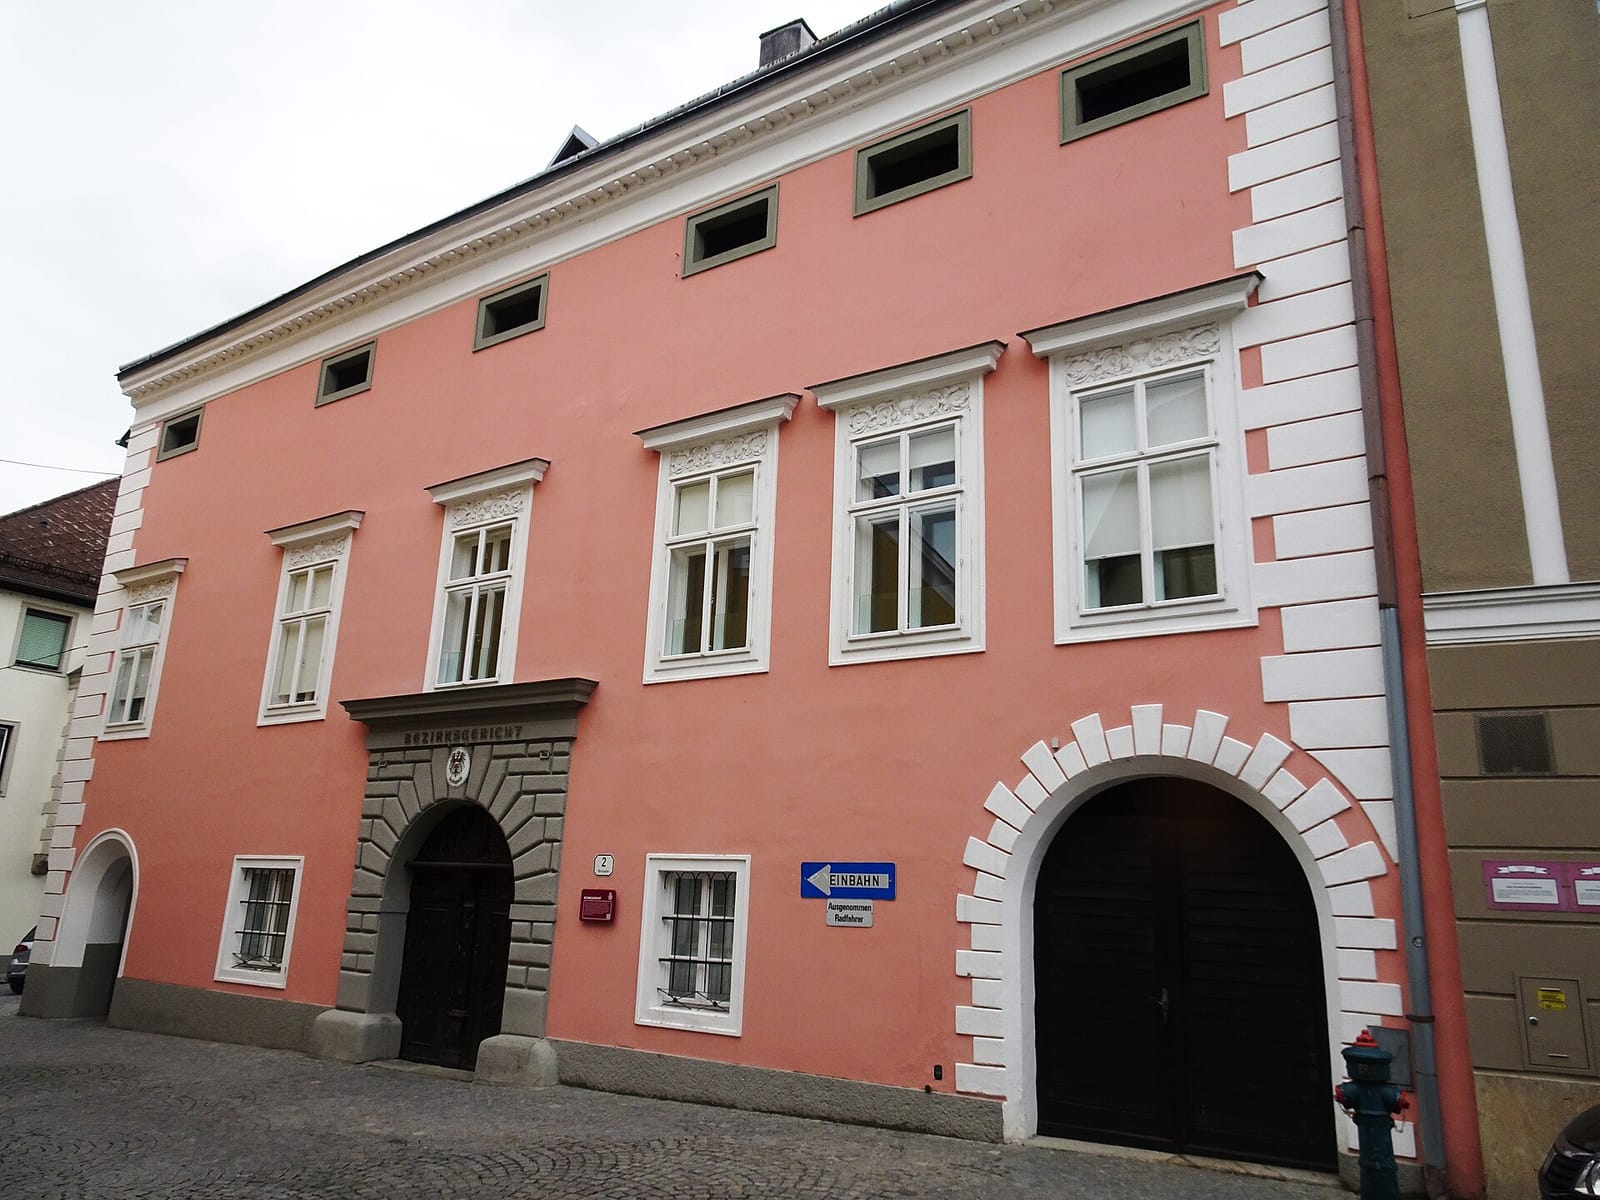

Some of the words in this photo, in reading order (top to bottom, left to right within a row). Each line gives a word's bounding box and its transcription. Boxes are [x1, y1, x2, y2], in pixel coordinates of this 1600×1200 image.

[404, 725, 522, 745] BEZIRKSGERICHT
[601, 857, 607, 867] 2
[829, 874, 880, 887] EINBAHN
[828, 902, 872, 912] Ausgenommen
[834, 913, 864, 923] Radfahrer
